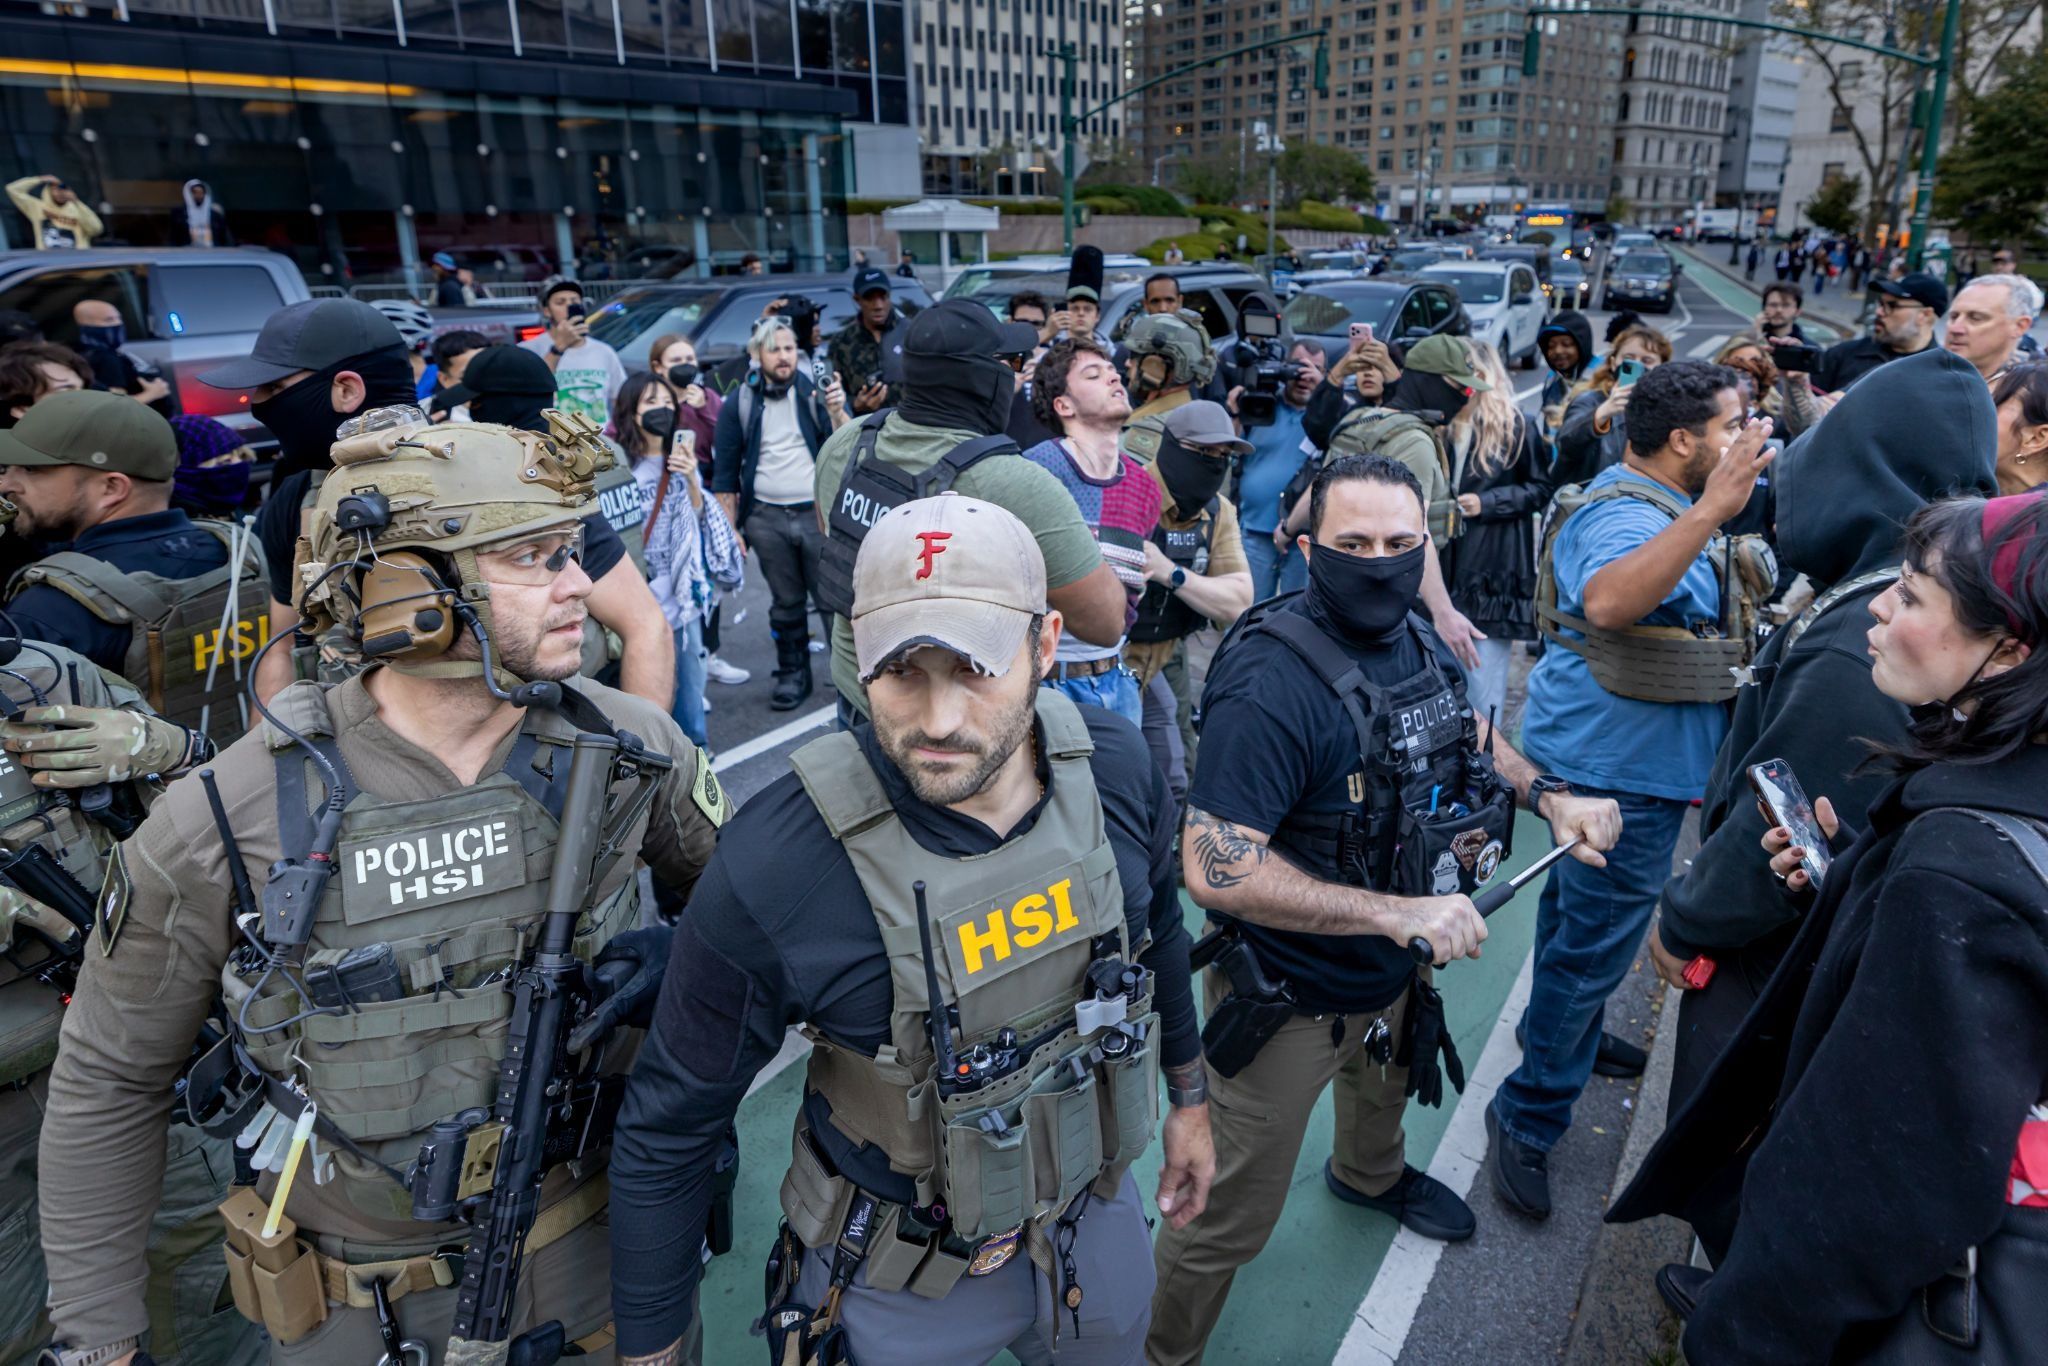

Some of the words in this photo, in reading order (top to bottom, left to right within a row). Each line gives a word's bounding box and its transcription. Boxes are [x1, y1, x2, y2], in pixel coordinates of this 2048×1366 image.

[600, 482, 640, 519] OLICE
[841, 488, 891, 528] POLI
[915, 531, 953, 580] F
[1167, 532, 1196, 546] POLICE
[194, 614, 268, 671] HSI
[1401, 694, 1456, 736] POLICE
[355, 822, 509, 884] POLICE
[389, 864, 484, 905] HSI
[957, 878, 1079, 975] HSI
